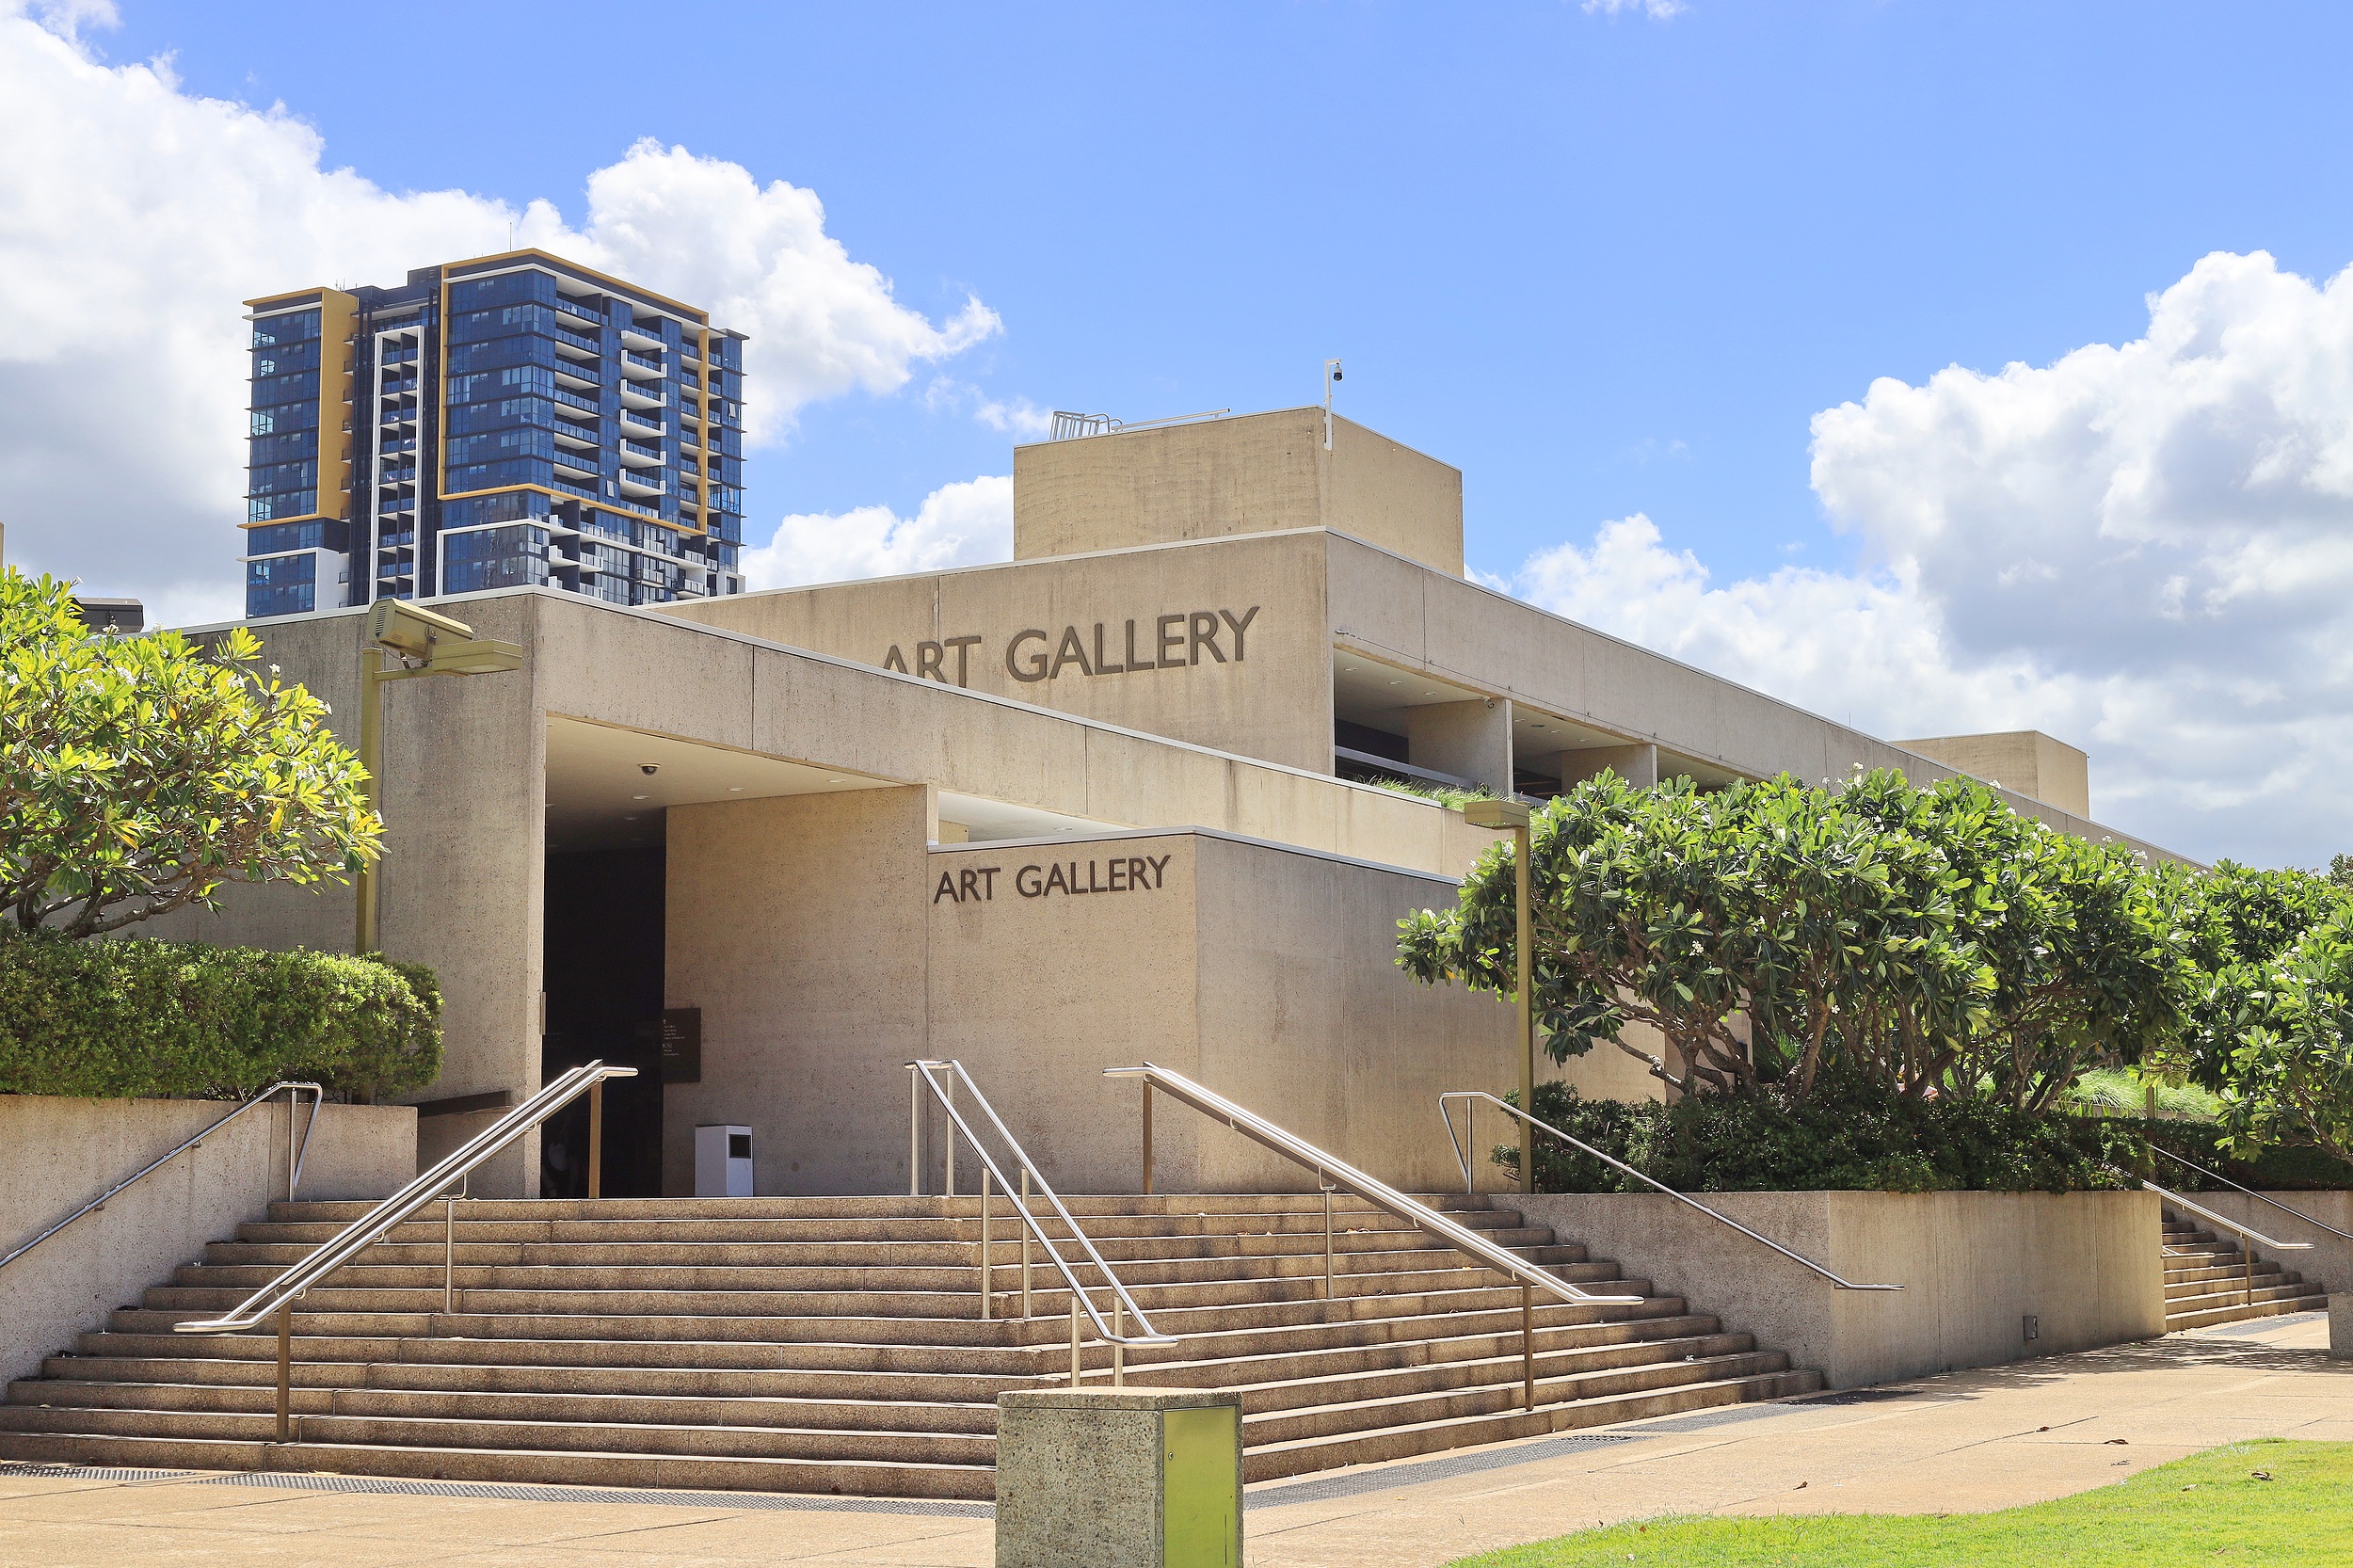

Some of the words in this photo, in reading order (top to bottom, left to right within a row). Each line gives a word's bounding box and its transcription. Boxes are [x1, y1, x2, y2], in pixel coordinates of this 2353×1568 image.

[1004, 605, 1261, 683] GALLERY
[934, 867, 1000, 904] ART
[1016, 855, 1171, 898] GALLERY
